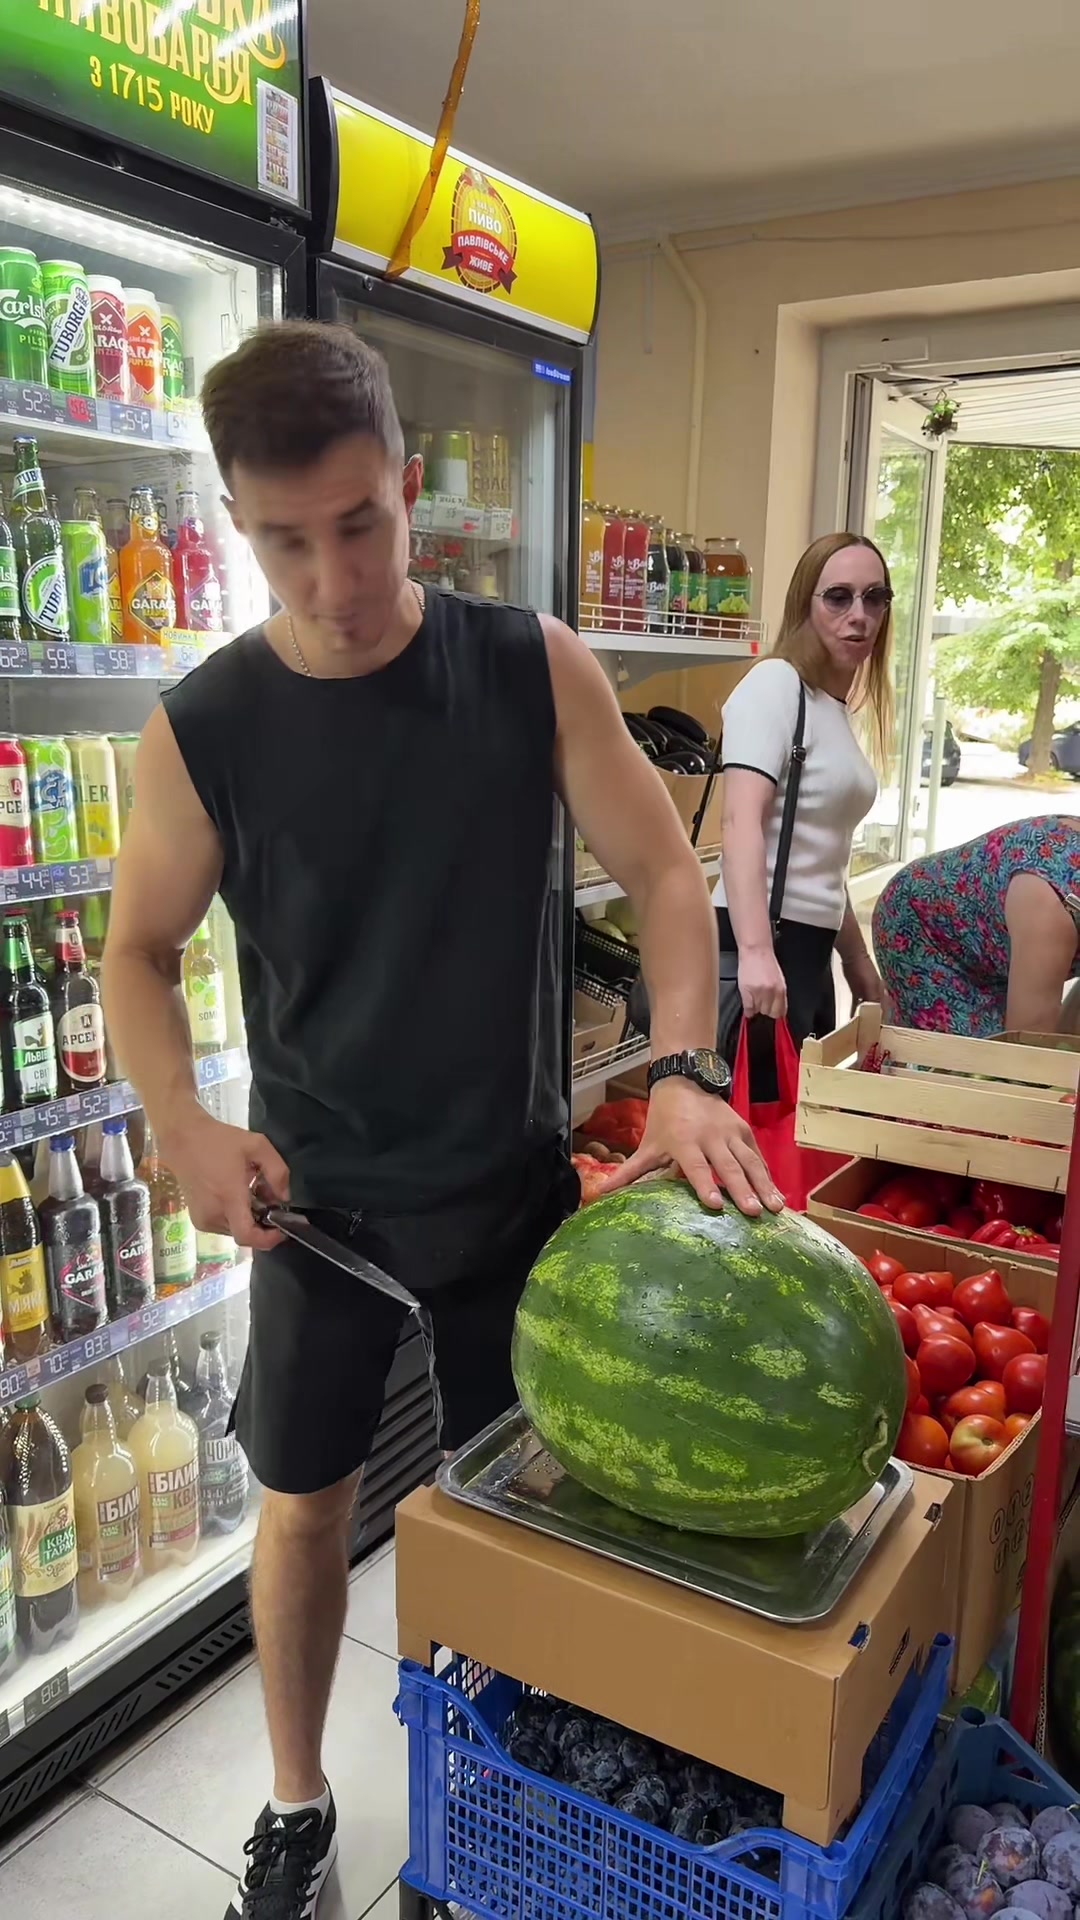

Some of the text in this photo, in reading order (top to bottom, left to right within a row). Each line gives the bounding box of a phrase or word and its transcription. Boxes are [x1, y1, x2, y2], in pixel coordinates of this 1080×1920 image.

[109, 62, 164, 112] 1715
[170, 90, 215, 134] РОКУ
[468, 207, 502, 235] ПИВО
[457, 235, 509, 266] ПАВЛІВСЬКЕ
[468, 254, 494, 274] ЖИВЕ
[50, 301, 87, 363] TUBORG
